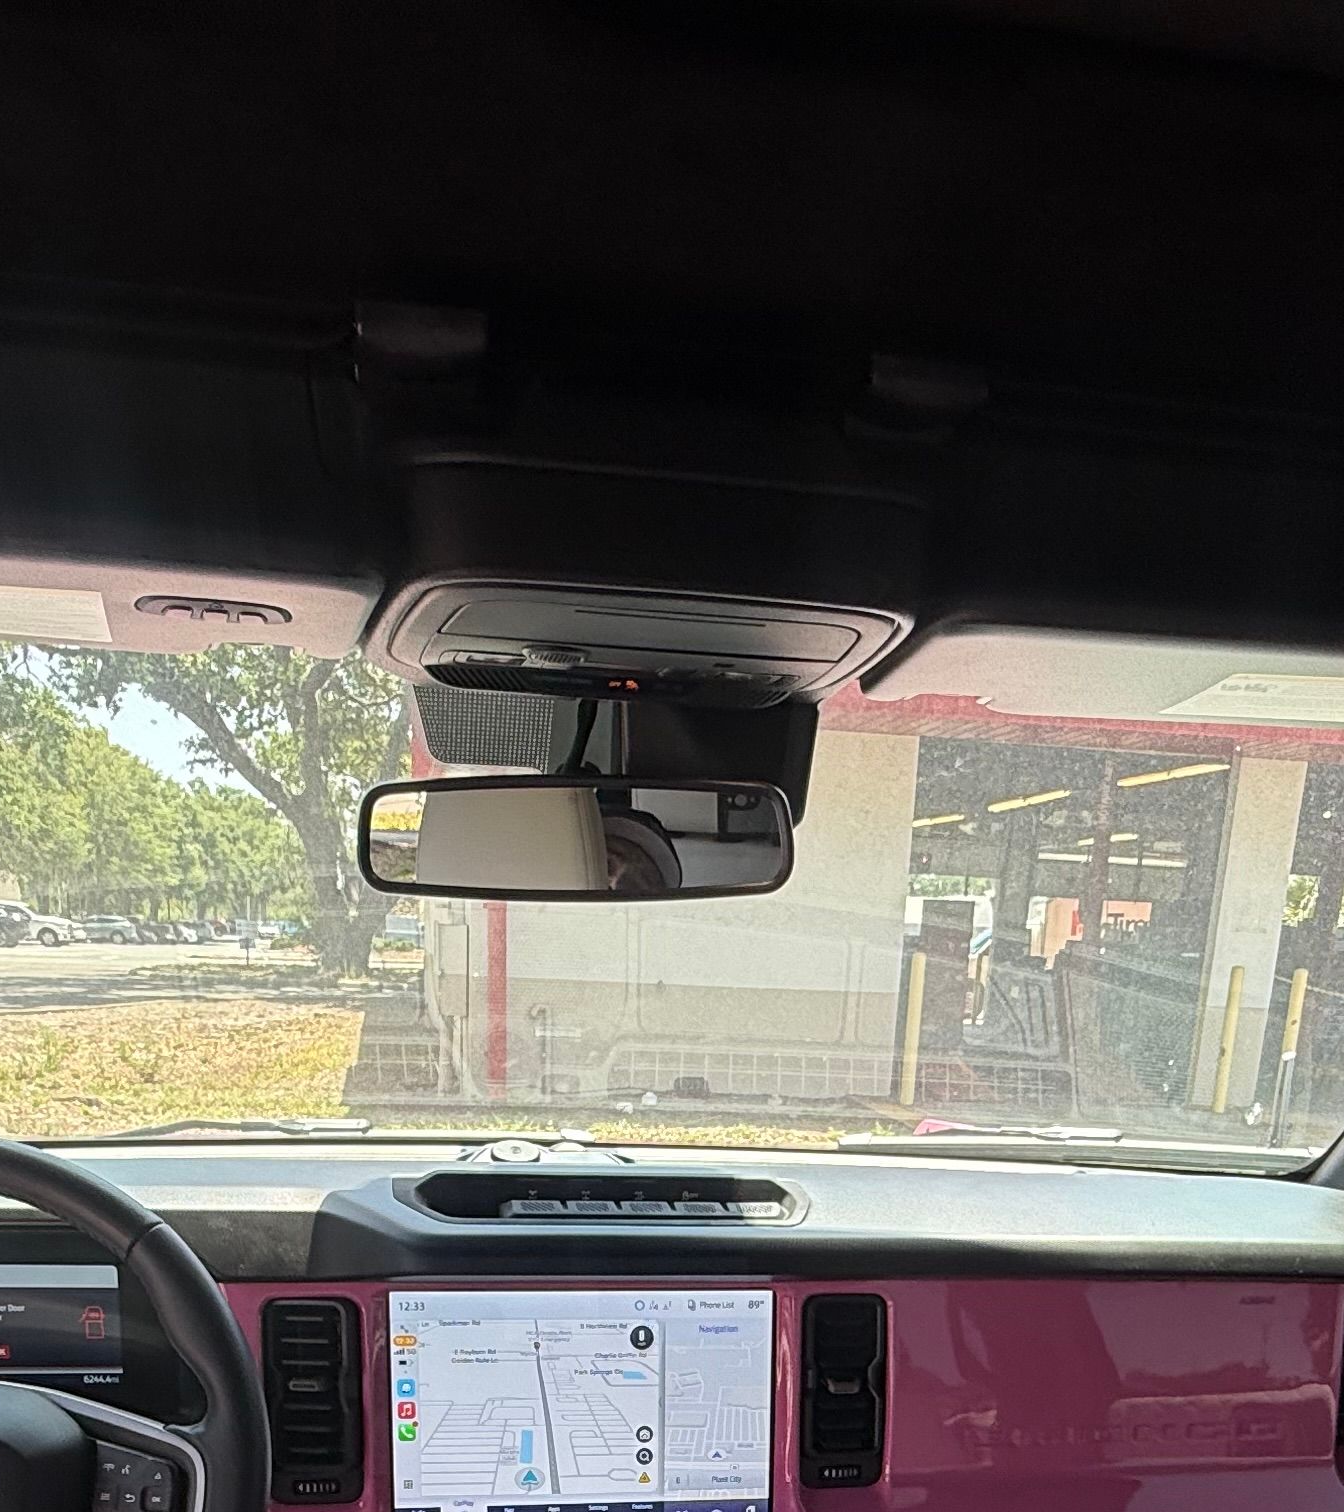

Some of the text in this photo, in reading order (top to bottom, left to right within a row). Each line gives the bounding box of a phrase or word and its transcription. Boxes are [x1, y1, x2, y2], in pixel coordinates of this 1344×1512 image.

[700, 1301, 735, 1309] Phone List
[698, 1325, 739, 1334] Navigation
